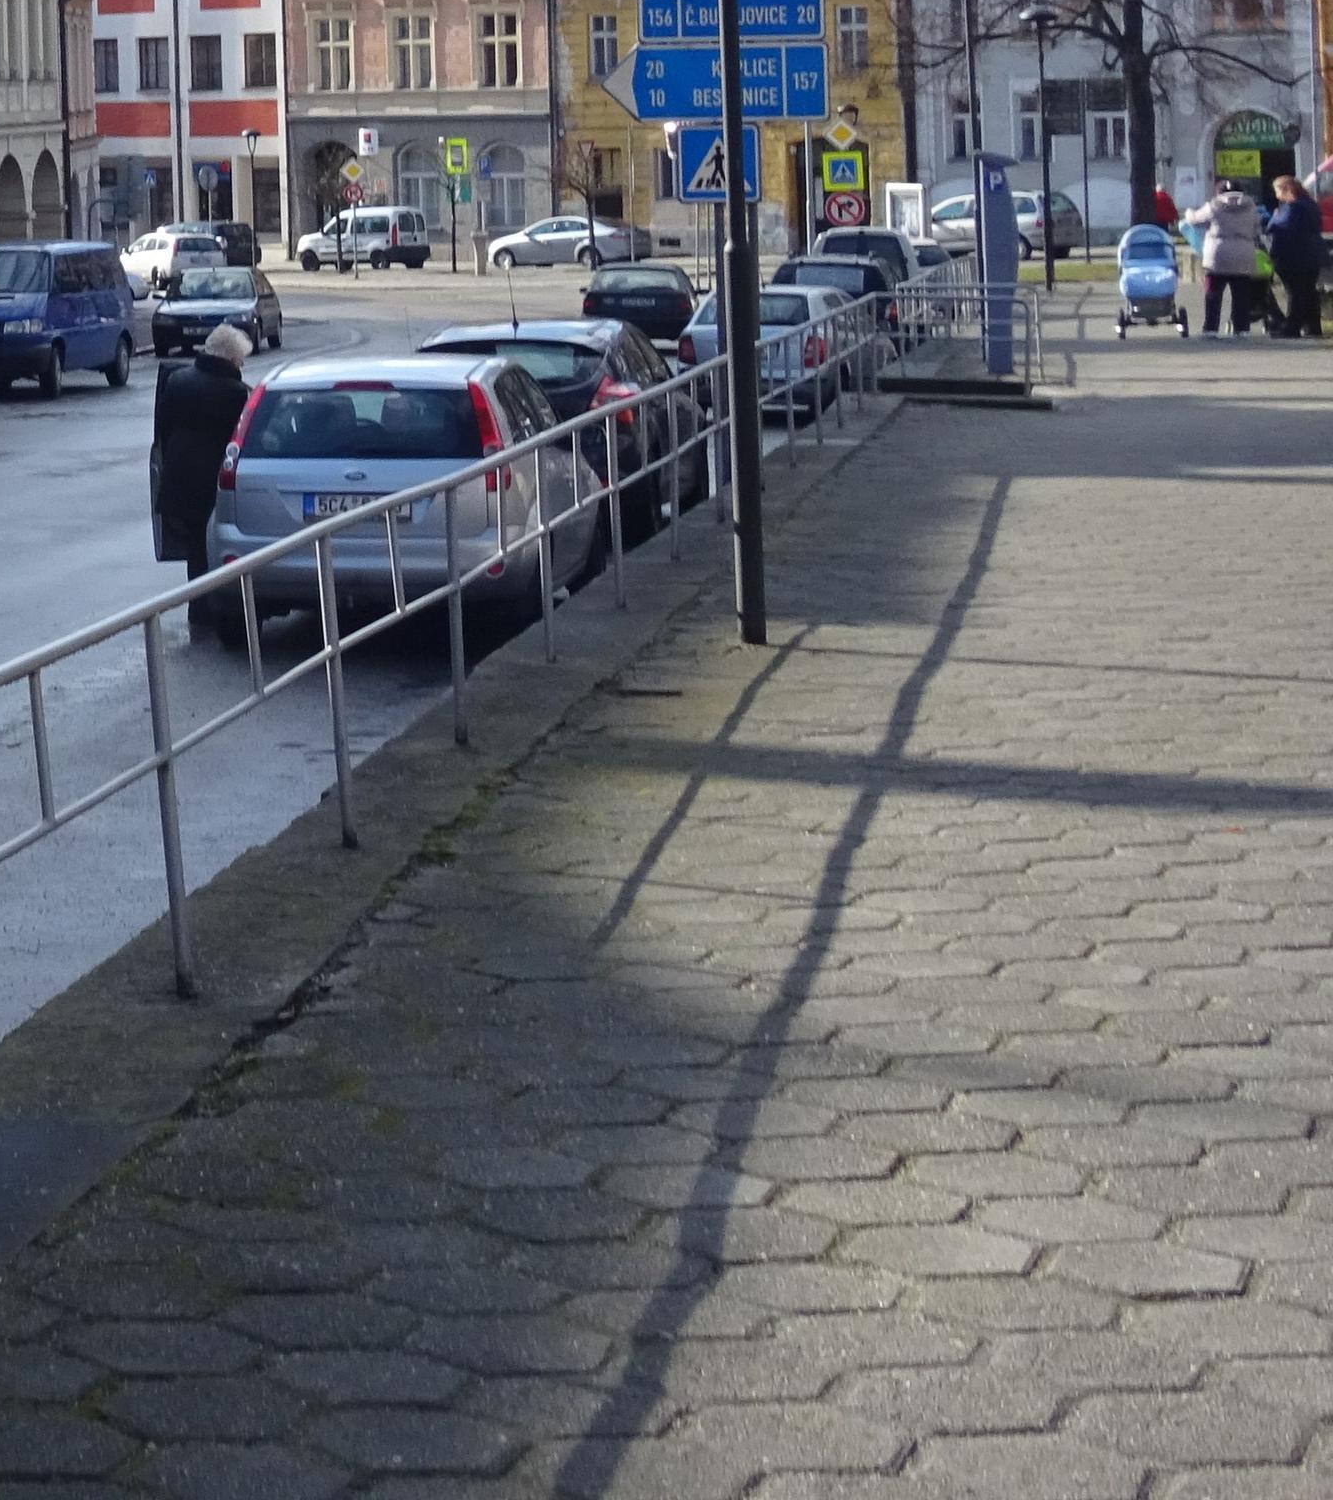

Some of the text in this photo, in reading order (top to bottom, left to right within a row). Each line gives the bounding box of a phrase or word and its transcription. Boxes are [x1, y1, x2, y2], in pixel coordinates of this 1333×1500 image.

[648, 4, 816, 27] 156 Č.BUJOVICE 20
[645, 57, 777, 79] 20 KLICE
[792, 72, 818, 90] 157
[648, 87, 779, 107] 10 BESNICE
